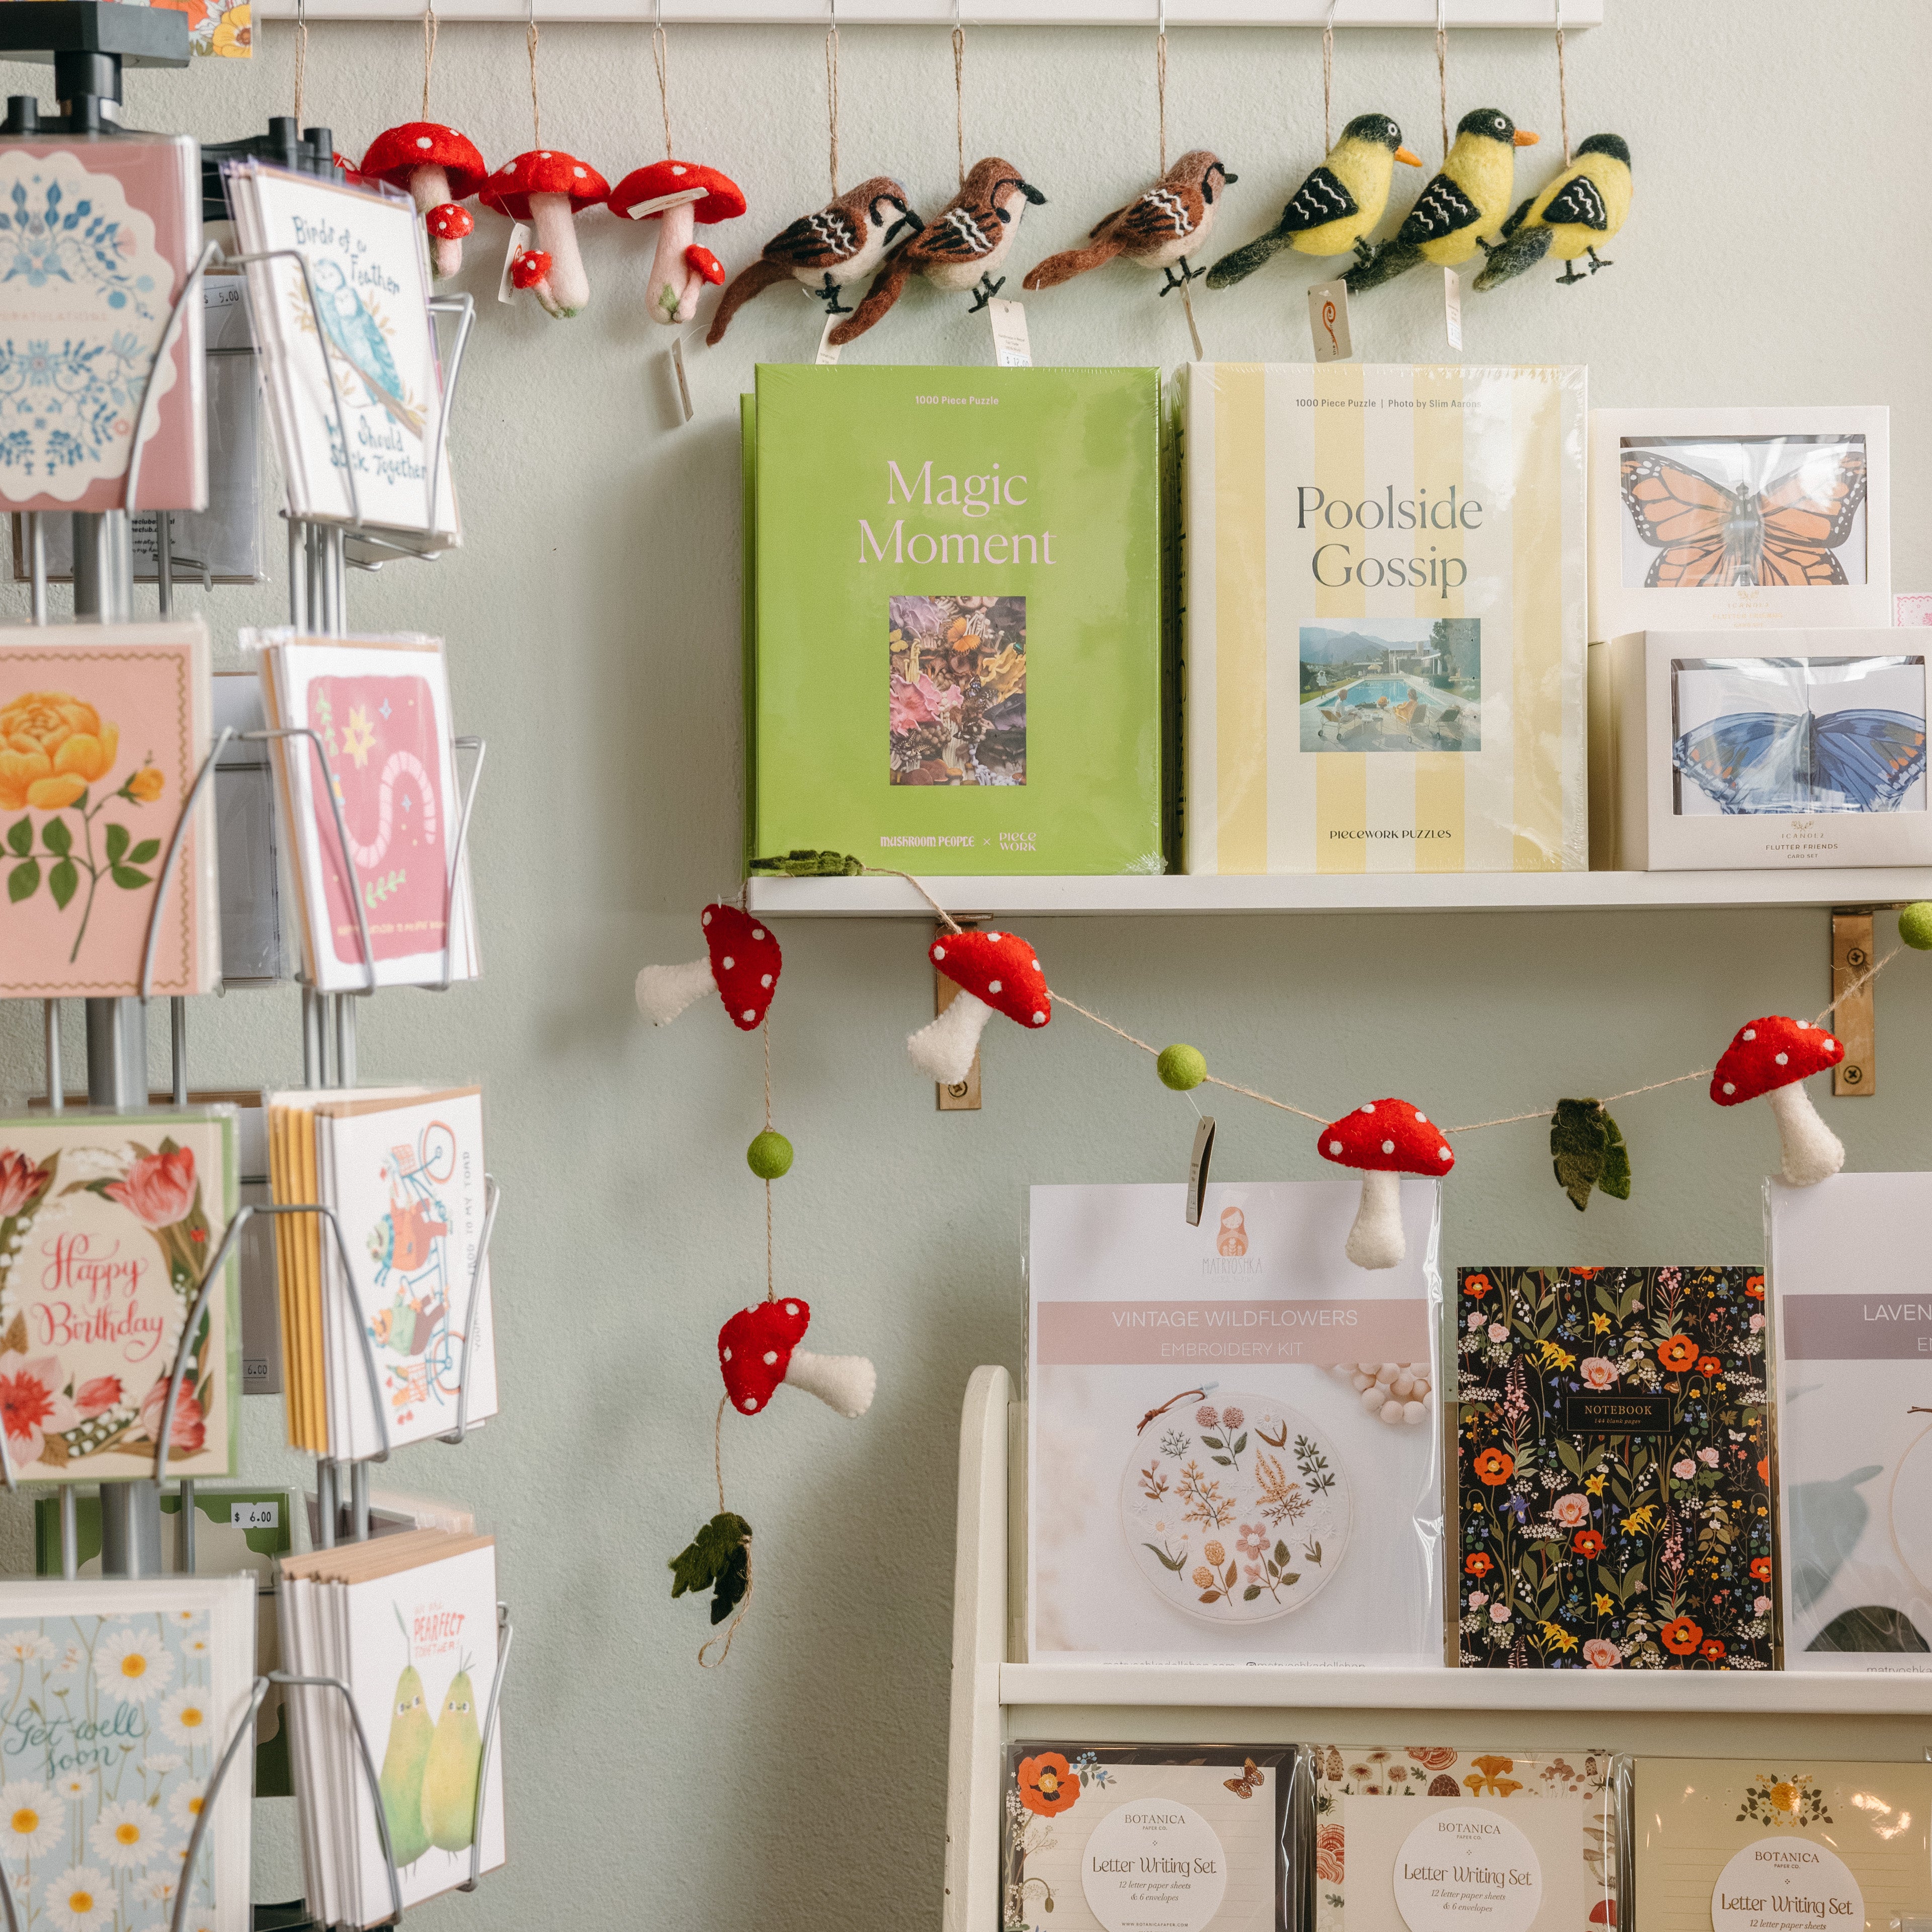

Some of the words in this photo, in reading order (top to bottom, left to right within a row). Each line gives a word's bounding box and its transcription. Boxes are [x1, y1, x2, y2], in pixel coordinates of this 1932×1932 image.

[219, 290, 239, 303] 5.00
[915, 396, 939, 404] 1000
[942, 396, 966, 404] Piece
[969, 396, 998, 404] Puzzle
[1296, 399, 1318, 407] 1000
[1348, 399, 1376, 407] Puzzle
[1416, 399, 1426, 409] by
[1451, 399, 1482, 408] Aarons
[887, 461, 1027, 518] Magic
[1297, 485, 1482, 529] Poolside
[859, 520, 1057, 564] Moment
[1312, 544, 1467, 599] Gossip
[1330, 830, 1398, 838] PIECEWORK
[881, 836, 936, 847] MUSHROOM
[939, 836, 974, 847] PEOPLE
[1000, 842, 1036, 851] WORK
[41, 1232, 149, 1304] Happy
[1202, 1257, 1263, 1274] MATRYOSHKA
[1112, 1311, 1199, 1327] VINTAGE
[1205, 1309, 1357, 1326] WILDFLOWERS
[1863, 1304, 1932, 1321] LAVEN
[30, 1299, 163, 1363] Birthday
[1161, 1342, 1272, 1357] EMBROIDERY
[1278, 1342, 1303, 1356] KIT
[247, 1365, 267, 1375] 6.00
[1585, 1405, 1651, 1414] NOTEBOOK
[234, 1511, 240, 1523] $
[249, 1511, 272, 1522] 6.00
[68, 1699, 149, 1742] well
[34, 1746, 120, 1780] soon
[1125, 1815, 1185, 1824] BOTANICA
[1439, 1823, 1500, 1834] BOTANICA
[1755, 1852, 1819, 1863] BOTANICA
[1094, 1857, 1135, 1872] Letter
[1140, 1858, 1190, 1877] Writing
[1194, 1858, 1216, 1873] Set
[1405, 1864, 1448, 1881] Letter
[1453, 1866, 1504, 1888] Writing
[1509, 1869, 1532, 1885] Set
[1128, 1880, 1146, 1889] letter
[1147, 1883, 1168, 1891] paper
[1170, 1881, 1191, 1890] sheets
[1145, 1893, 1179, 1903] envelopes
[1441, 1889, 1459, 1897] letter
[1484, 1892, 1505, 1900] sheets
[1458, 1903, 1492, 1913] envelopes
[1722, 1893, 1767, 1911] Letter
[1772, 1896, 1824, 1918] Writing
[1829, 1898, 1853, 1914] Set
[1760, 1919, 1780, 1927] letter
[1780, 1922, 1803, 1931] paper
[1804, 1921, 1827, 1930] sheets
